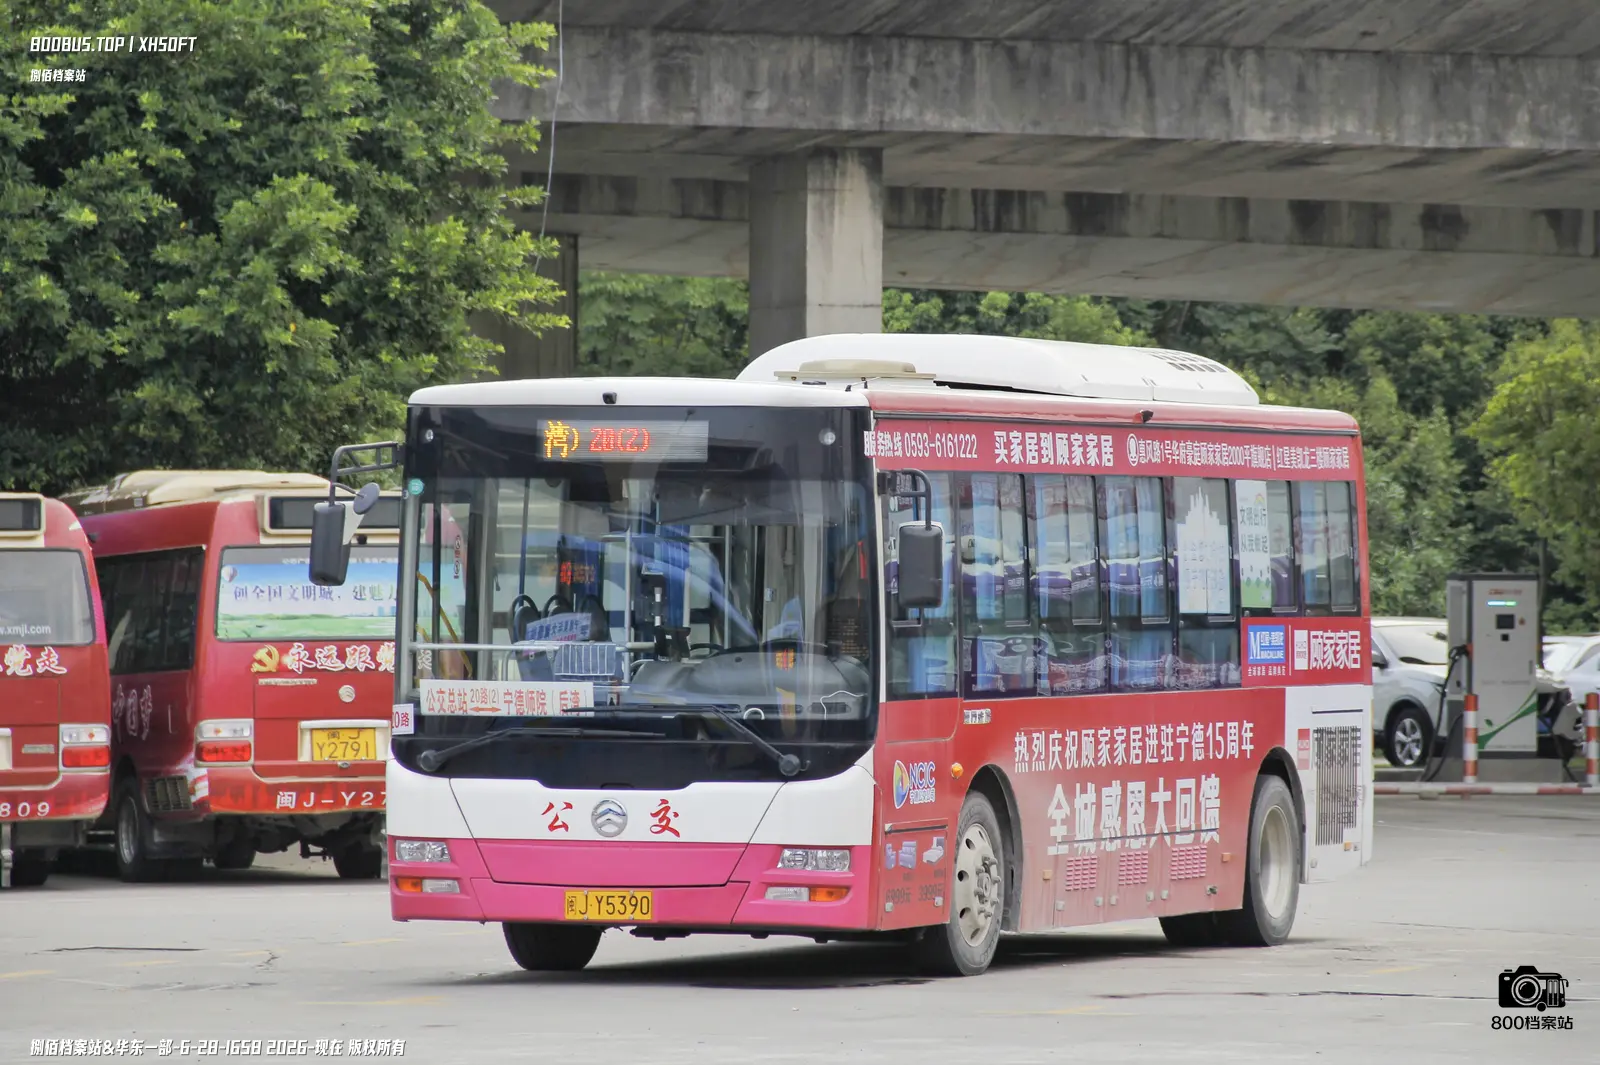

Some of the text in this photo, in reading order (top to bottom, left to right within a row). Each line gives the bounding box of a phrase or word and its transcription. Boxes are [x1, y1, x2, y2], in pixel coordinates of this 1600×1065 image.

[863, 430, 903, 458] 服务热线
[904, 432, 978, 459] 0593-6161222
[994, 431, 1114, 467] 买家居到顾家家居
[1310, 630, 1361, 670] 顾家家居
[426, 688, 468, 714] 公交总站
[470, 687, 500, 706] 20路(2)
[392, 711, 409, 728] 0路
[316, 741, 369, 758] Y2791
[1015, 720, 1254, 773] 热烈庆祝顾家家居进驻宁德15周年
[909, 761, 935, 789] NCIC
[1047, 773, 1220, 856] 全城感恩大回馈
